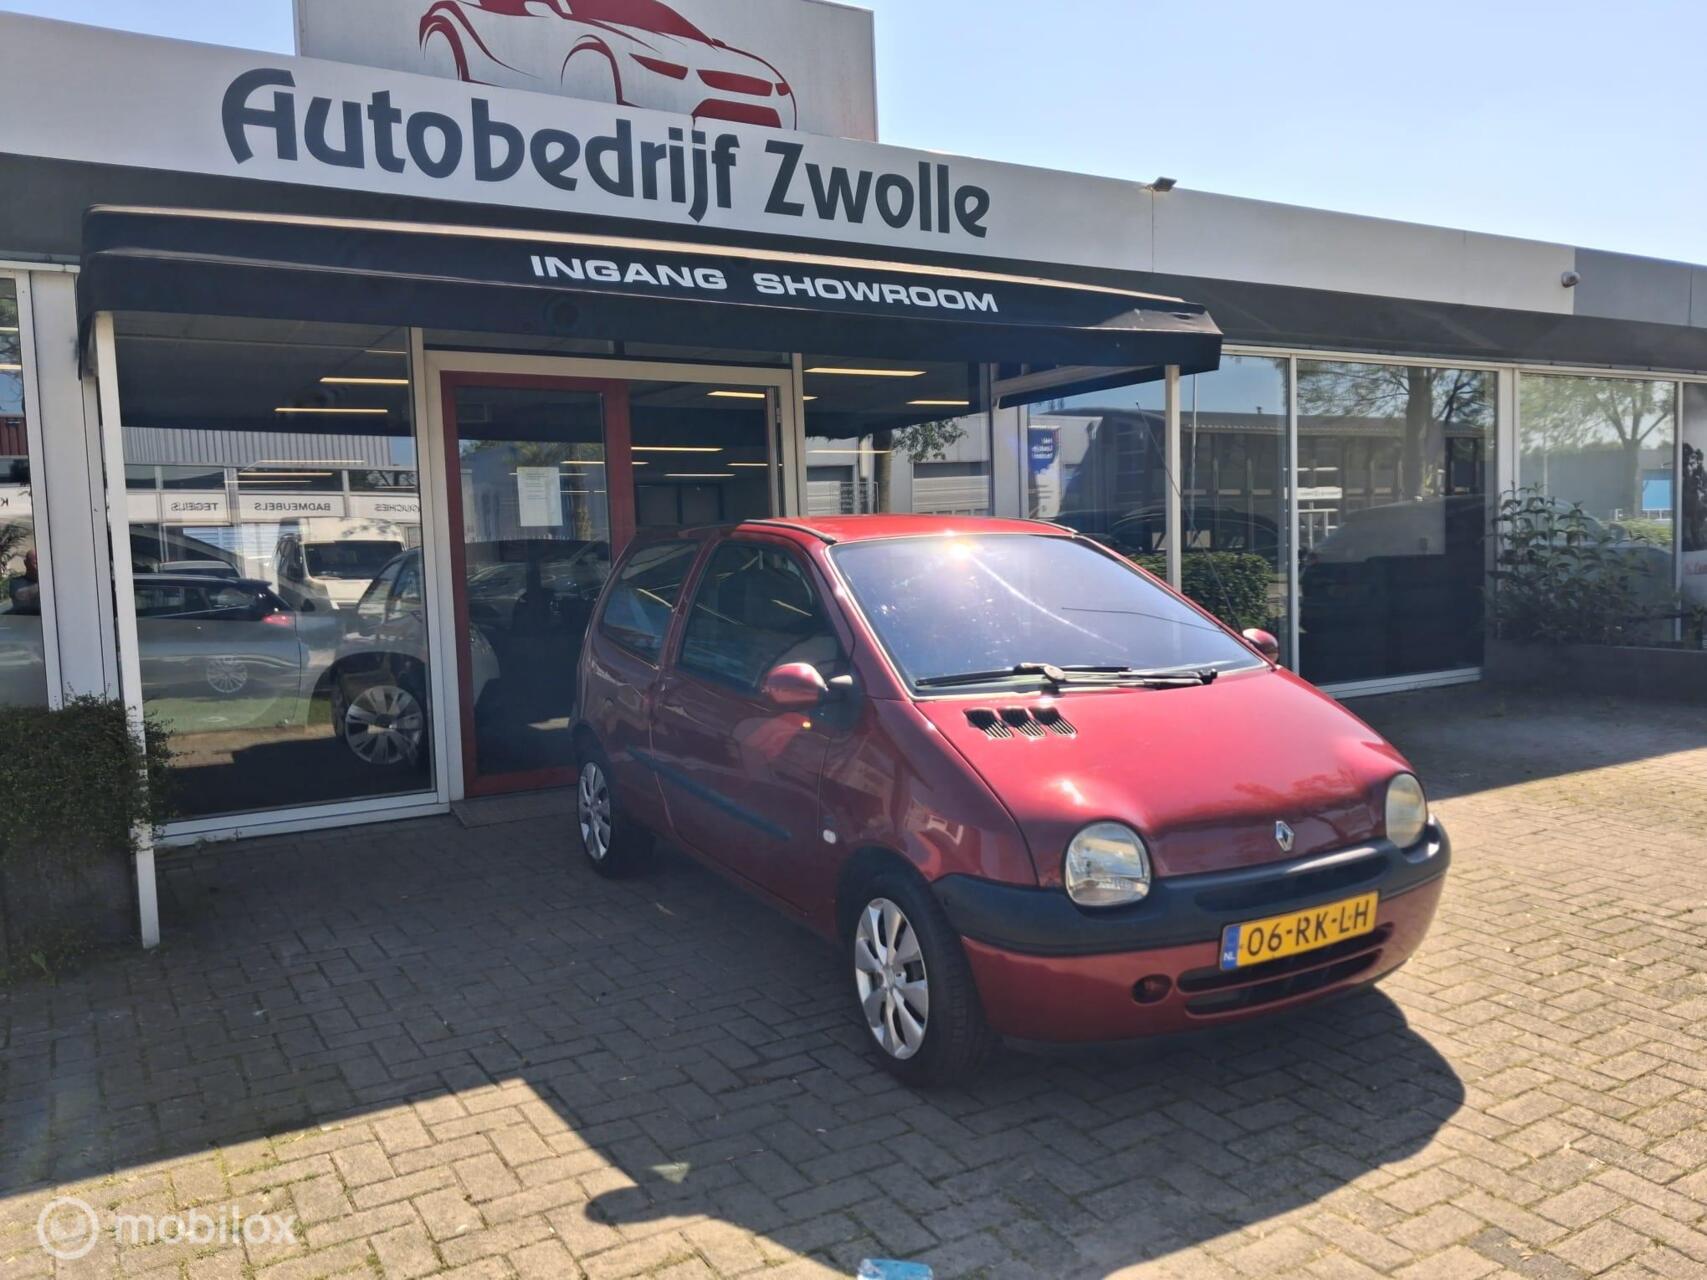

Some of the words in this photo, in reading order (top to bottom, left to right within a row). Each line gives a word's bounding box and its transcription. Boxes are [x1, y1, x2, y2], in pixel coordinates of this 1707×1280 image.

[221, 67, 740, 223] Autobedrijf
[765, 139, 991, 239] Zwolle
[530, 254, 728, 290] INGANG
[755, 273, 999, 313] SHOWROOM
[1223, 952, 1236, 961] NL
[1247, 899, 1369, 956] 06-RK-LH
